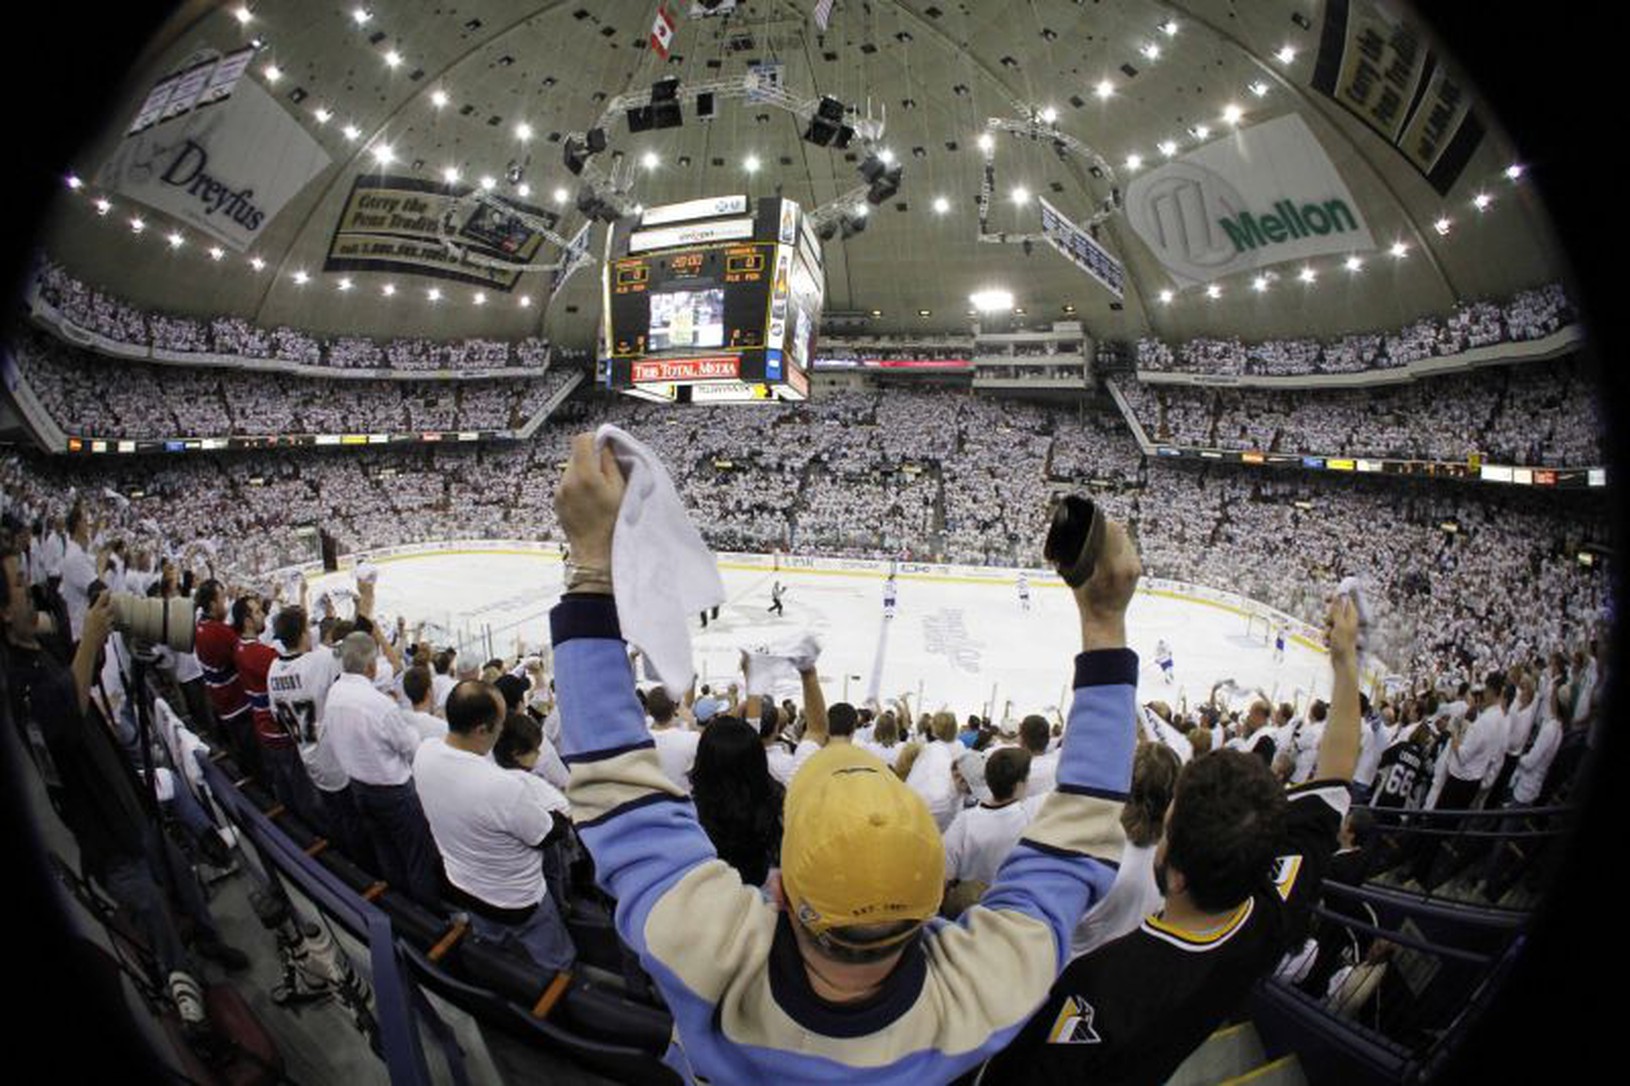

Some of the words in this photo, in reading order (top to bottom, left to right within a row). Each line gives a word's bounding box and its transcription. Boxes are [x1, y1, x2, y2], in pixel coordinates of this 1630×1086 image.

[160, 139, 264, 231] Dreyfus
[1219, 199, 1358, 252] Mellon
[660, 362, 695, 377] TOTAL
[697, 362, 737, 375] MEDIA
[271, 673, 302, 691] CROSBY
[1385, 763, 1416, 797] 66
